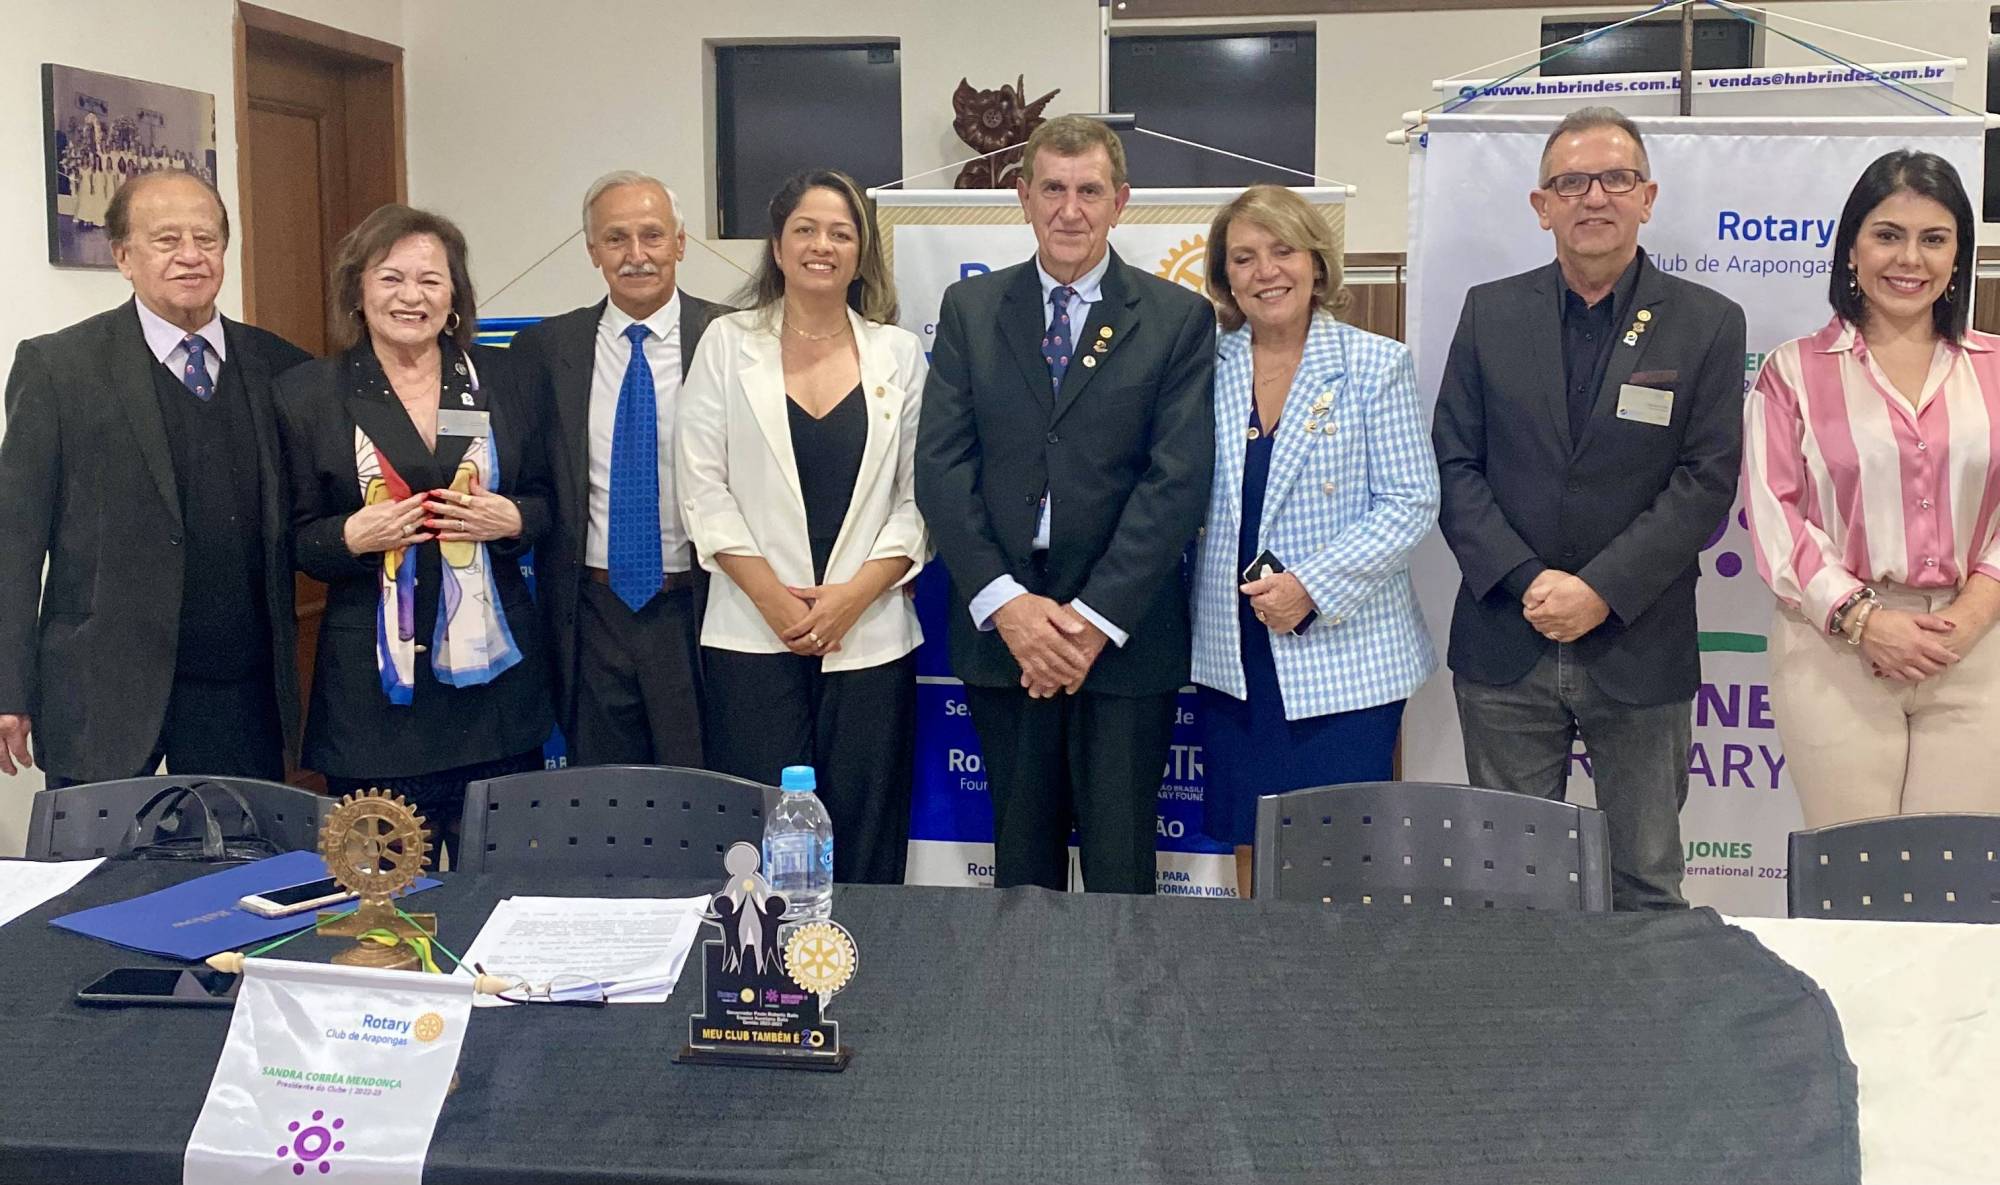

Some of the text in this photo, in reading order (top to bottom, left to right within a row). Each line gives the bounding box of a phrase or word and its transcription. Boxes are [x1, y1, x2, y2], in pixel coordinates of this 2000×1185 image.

[1483, 77, 1682, 97] www.hnbrindes.com.b
[1708, 66, 1945, 89] vendas@hnbrindes.com.br
[1718, 211, 1836, 248] Rotary
[1695, 254, 1720, 273] de
[1686, 842, 1753, 862] JONES
[1163, 871, 1190, 882] PARA
[1685, 865, 1754, 878] ernational
[1205, 887, 1238, 898] VIDAS
[362, 1014, 412, 1034] Rotary
[325, 1028, 409, 1047] Club de Arapongas
[702, 1028, 723, 1041] MEU
[724, 1030, 751, 1042] CLUB
[752, 1030, 792, 1044] TAMBÉM
[793, 1032, 801, 1045] É
[262, 1065, 304, 1082] SANDRA
[345, 1074, 403, 1090] MENDONÇA
